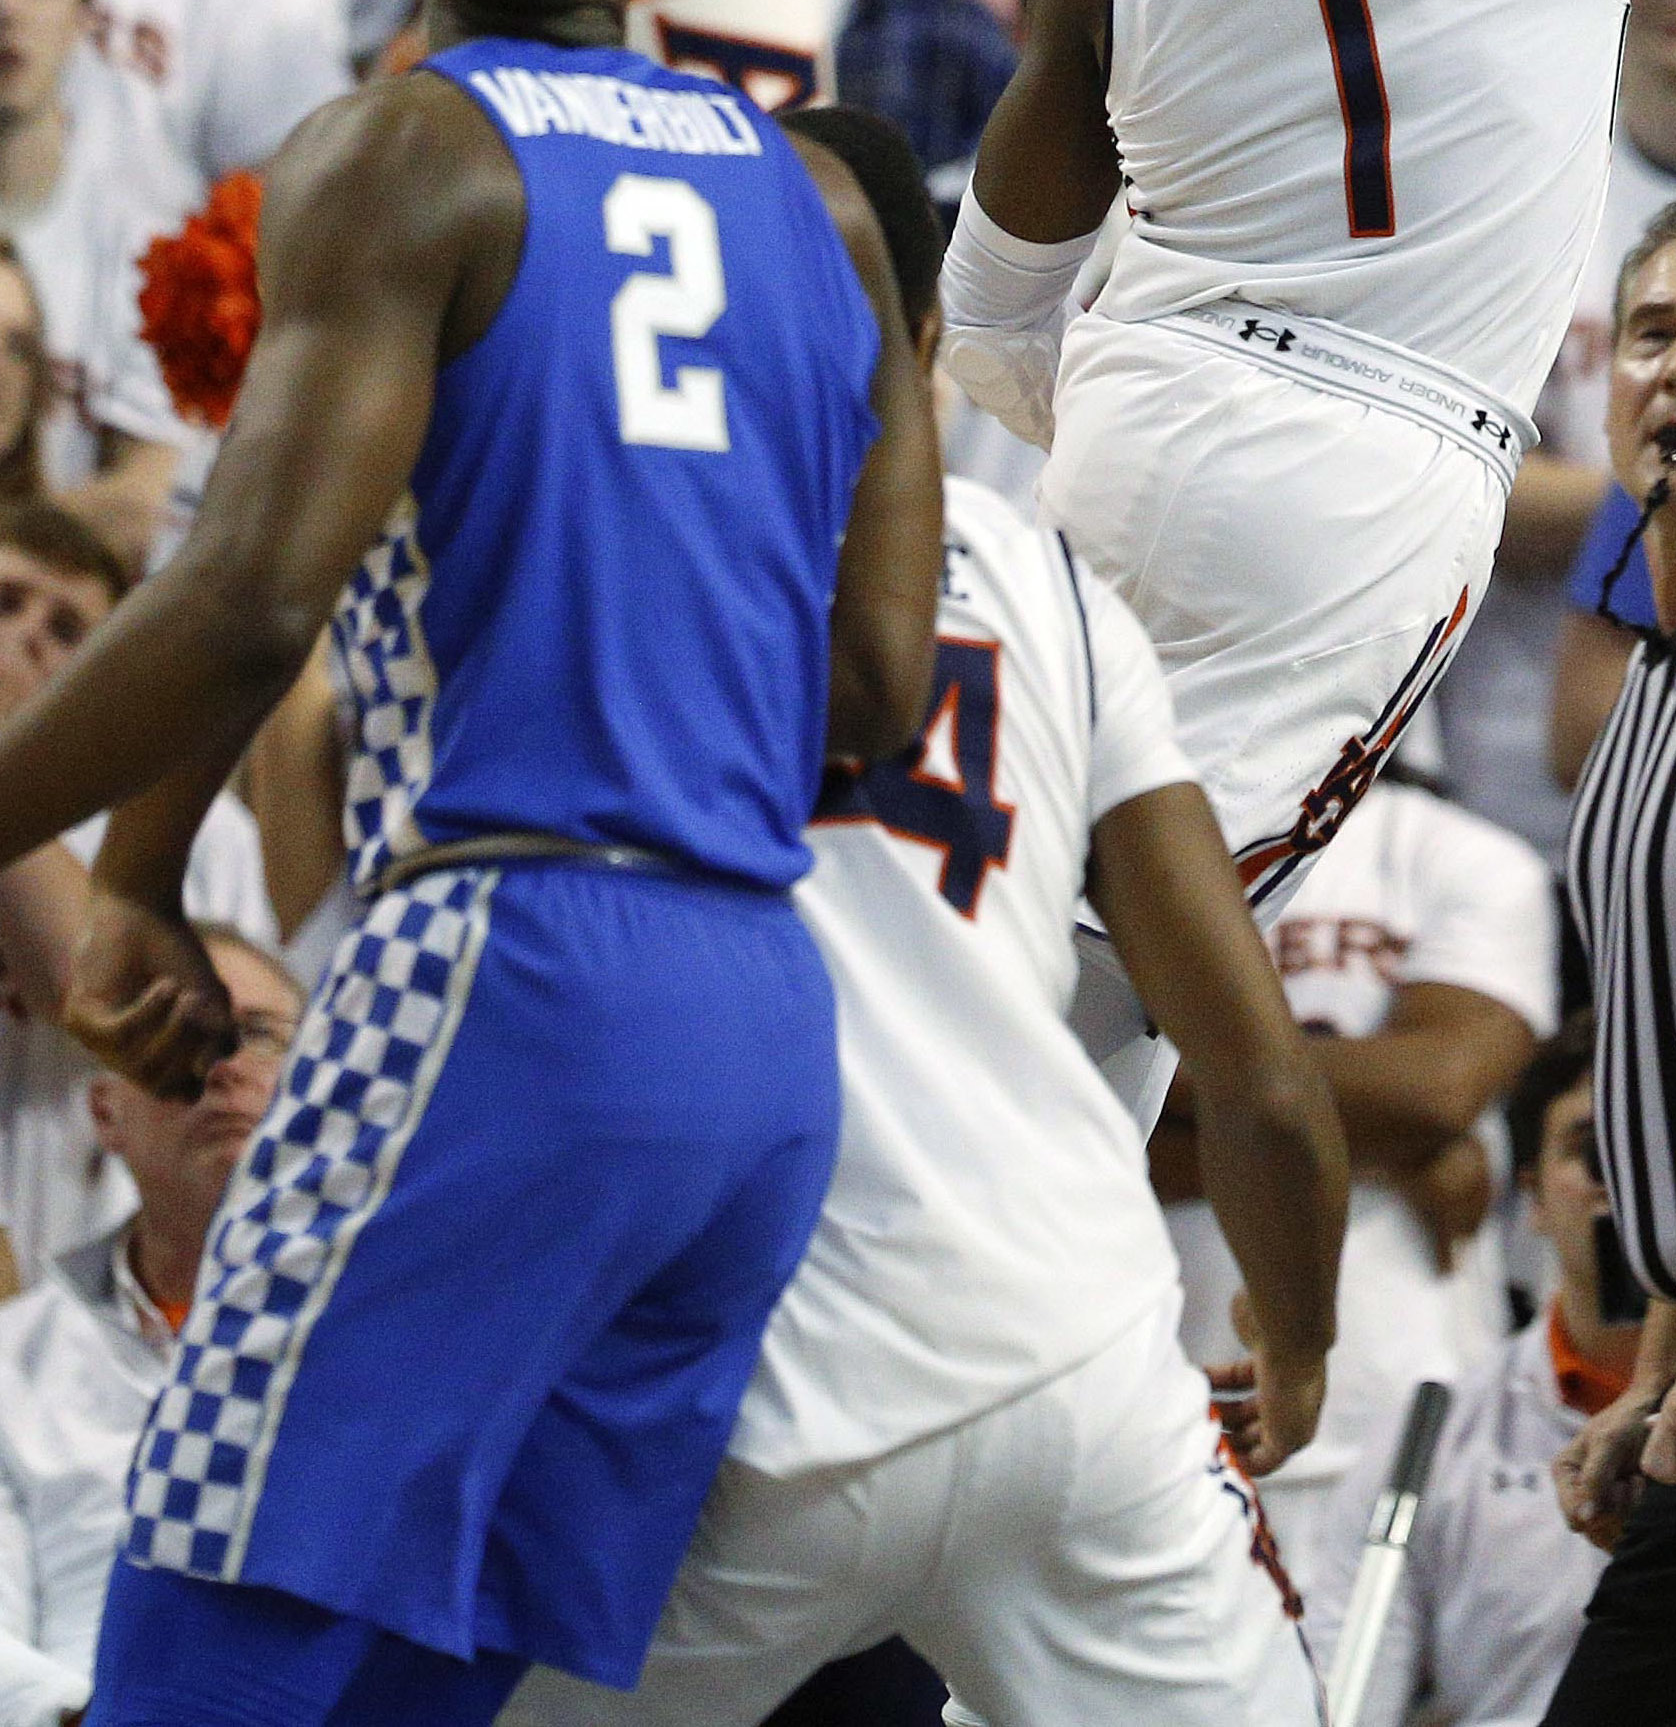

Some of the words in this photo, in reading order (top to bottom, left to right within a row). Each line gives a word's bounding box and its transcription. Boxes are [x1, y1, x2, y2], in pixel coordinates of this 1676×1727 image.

[470, 67, 763, 156] VANDERBILT
[603, 174, 730, 454] 2
[1300, 343, 1394, 383] ARMOUR
[1399, 371, 1466, 418] UNDER
